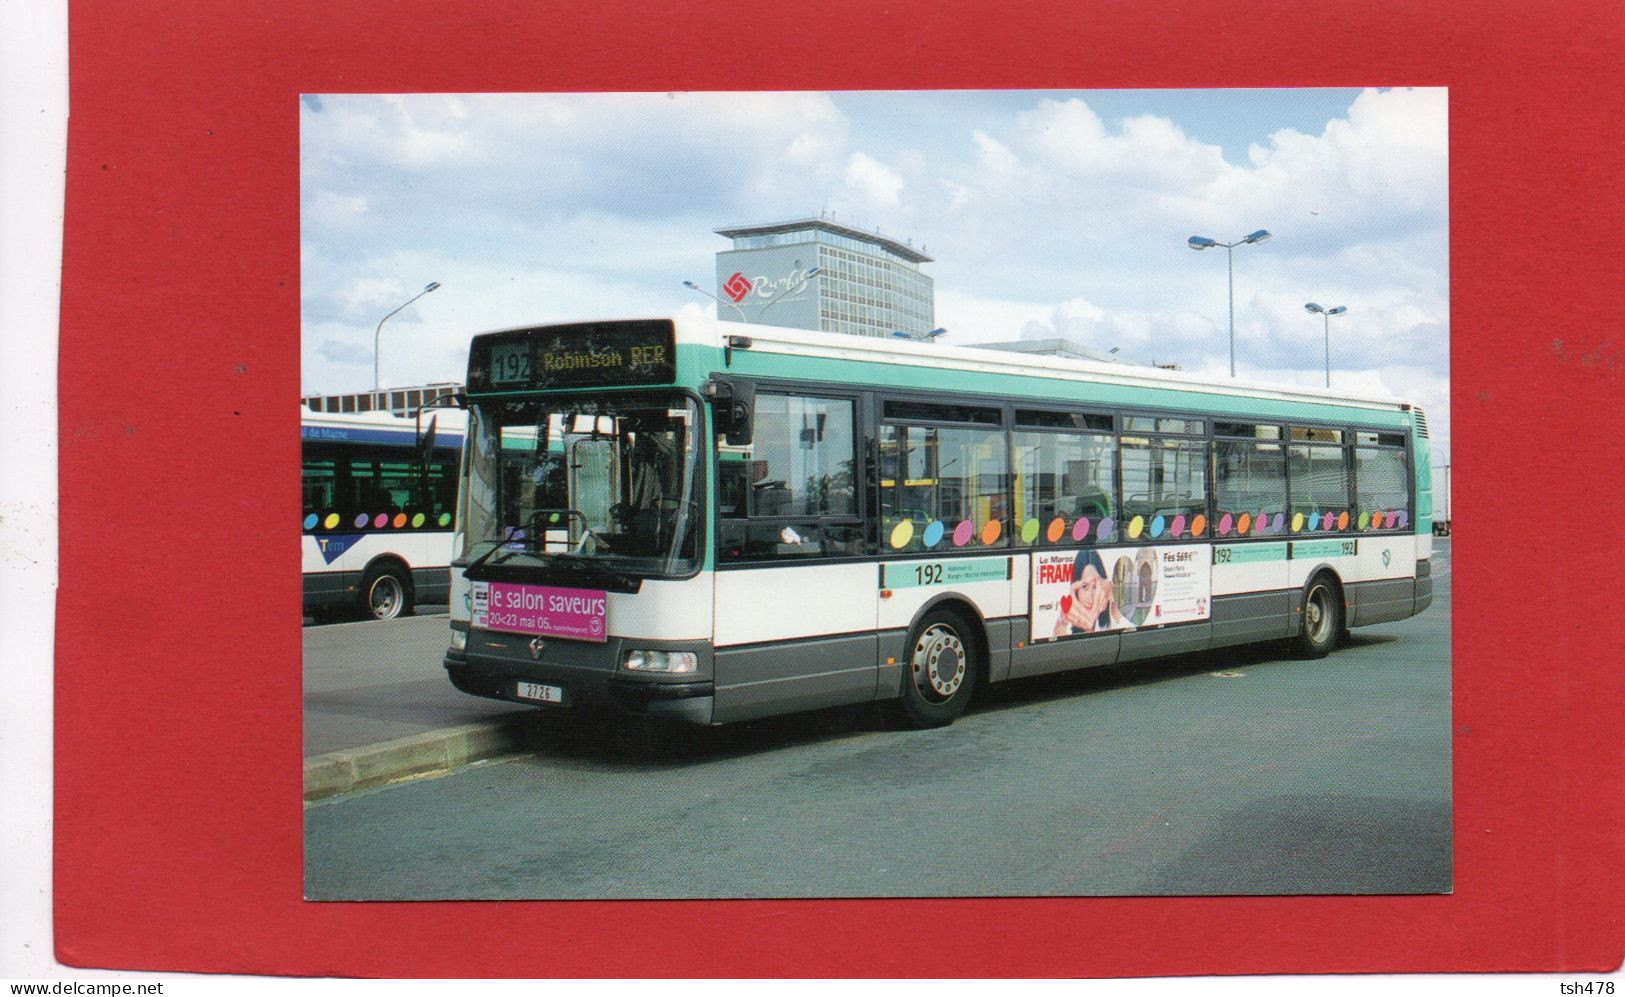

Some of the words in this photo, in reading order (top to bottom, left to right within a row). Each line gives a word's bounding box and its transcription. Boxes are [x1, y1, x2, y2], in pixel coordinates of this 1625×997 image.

[544, 351, 623, 371] Robinson
[631, 345, 666, 366] RER
[496, 352, 530, 381] 192
[308, 427, 320, 438] de
[321, 428, 349, 440] Marne
[1216, 549, 1232, 563] 192
[1341, 542, 1354, 556] 192
[1051, 555, 1074, 564] Maroc
[915, 564, 943, 586] 192
[1039, 563, 1075, 584] FRAM
[490, 585, 502, 607] le
[506, 587, 544, 611] salon
[549, 594, 606, 616] saveurs
[519, 615, 535, 628] mai
[527, 684, 551, 700] 2726
